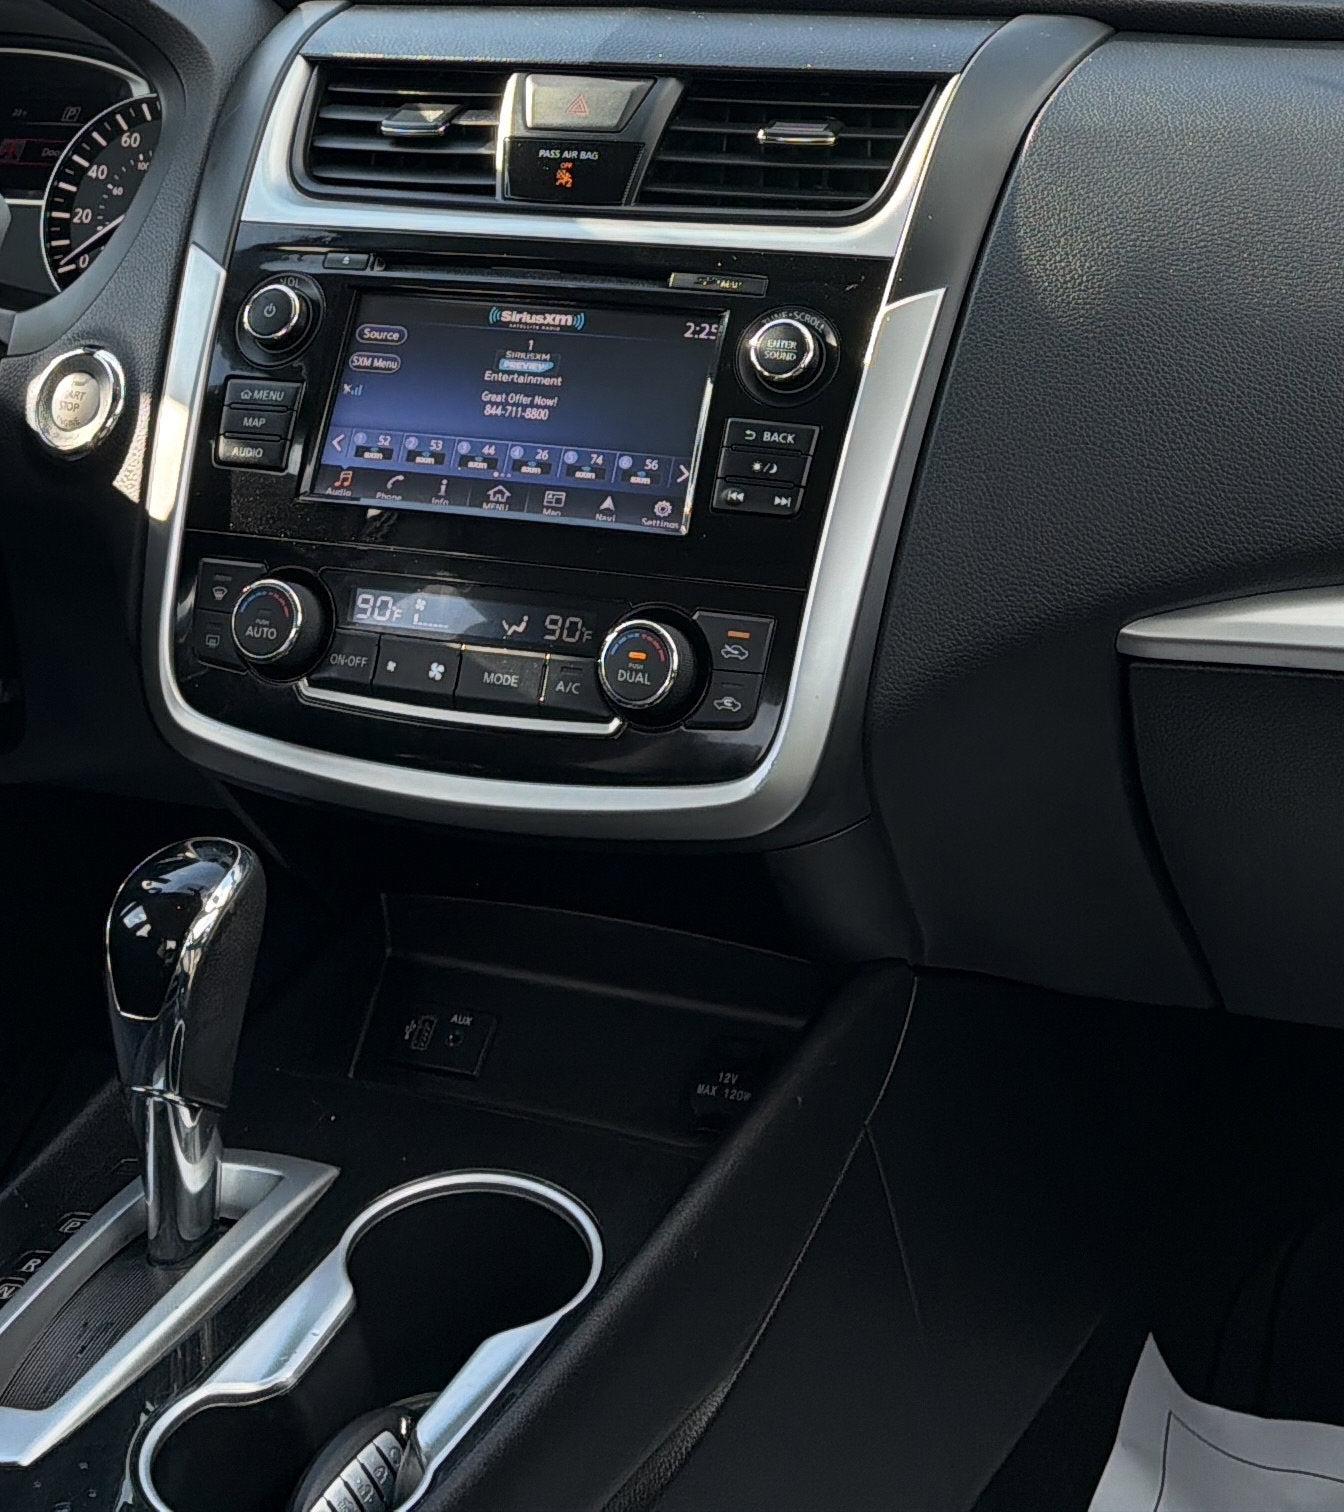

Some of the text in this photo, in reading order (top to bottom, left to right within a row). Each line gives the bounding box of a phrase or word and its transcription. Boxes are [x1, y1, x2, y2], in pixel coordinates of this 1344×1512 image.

[121, 132, 140, 148] 60
[539, 149, 599, 160] PASS AIR BAG
[88, 164, 107, 180] 40
[112, 186, 123, 196] 60
[73, 208, 92, 223] 20
[79, 254, 89, 269] 0
[363, 328, 400, 340] Source
[528, 339, 535, 351] 1
[767, 339, 797, 350] ENTER
[764, 350, 796, 361] SOUND
[352, 356, 398, 370] SXM Menu
[484, 371, 562, 386] Entertainment
[253, 389, 285, 402] MENU
[481, 391, 558, 408] Great Offer Now!
[483, 404, 549, 420] 844-711-8800
[243, 416, 266, 427] MAP
[763, 430, 796, 445] BACK
[231, 445, 264, 459] AUDIO
[378, 435, 659, 471] 52 53 44 26 74 56
[326, 487, 352, 497] Audio
[376, 491, 402, 501] Phone
[595, 514, 616, 522] Navi
[245, 626, 277, 640] AUTO
[483, 671, 519, 687] MODE
[617, 669, 651, 686] DUAL
[555, 681, 581, 695] A/C
[450, 1013, 473, 1027] AUX
[718, 1071, 739, 1085] 12V
[696, 1083, 719, 1097] MAX
[21, 1258, 42, 1273] R
